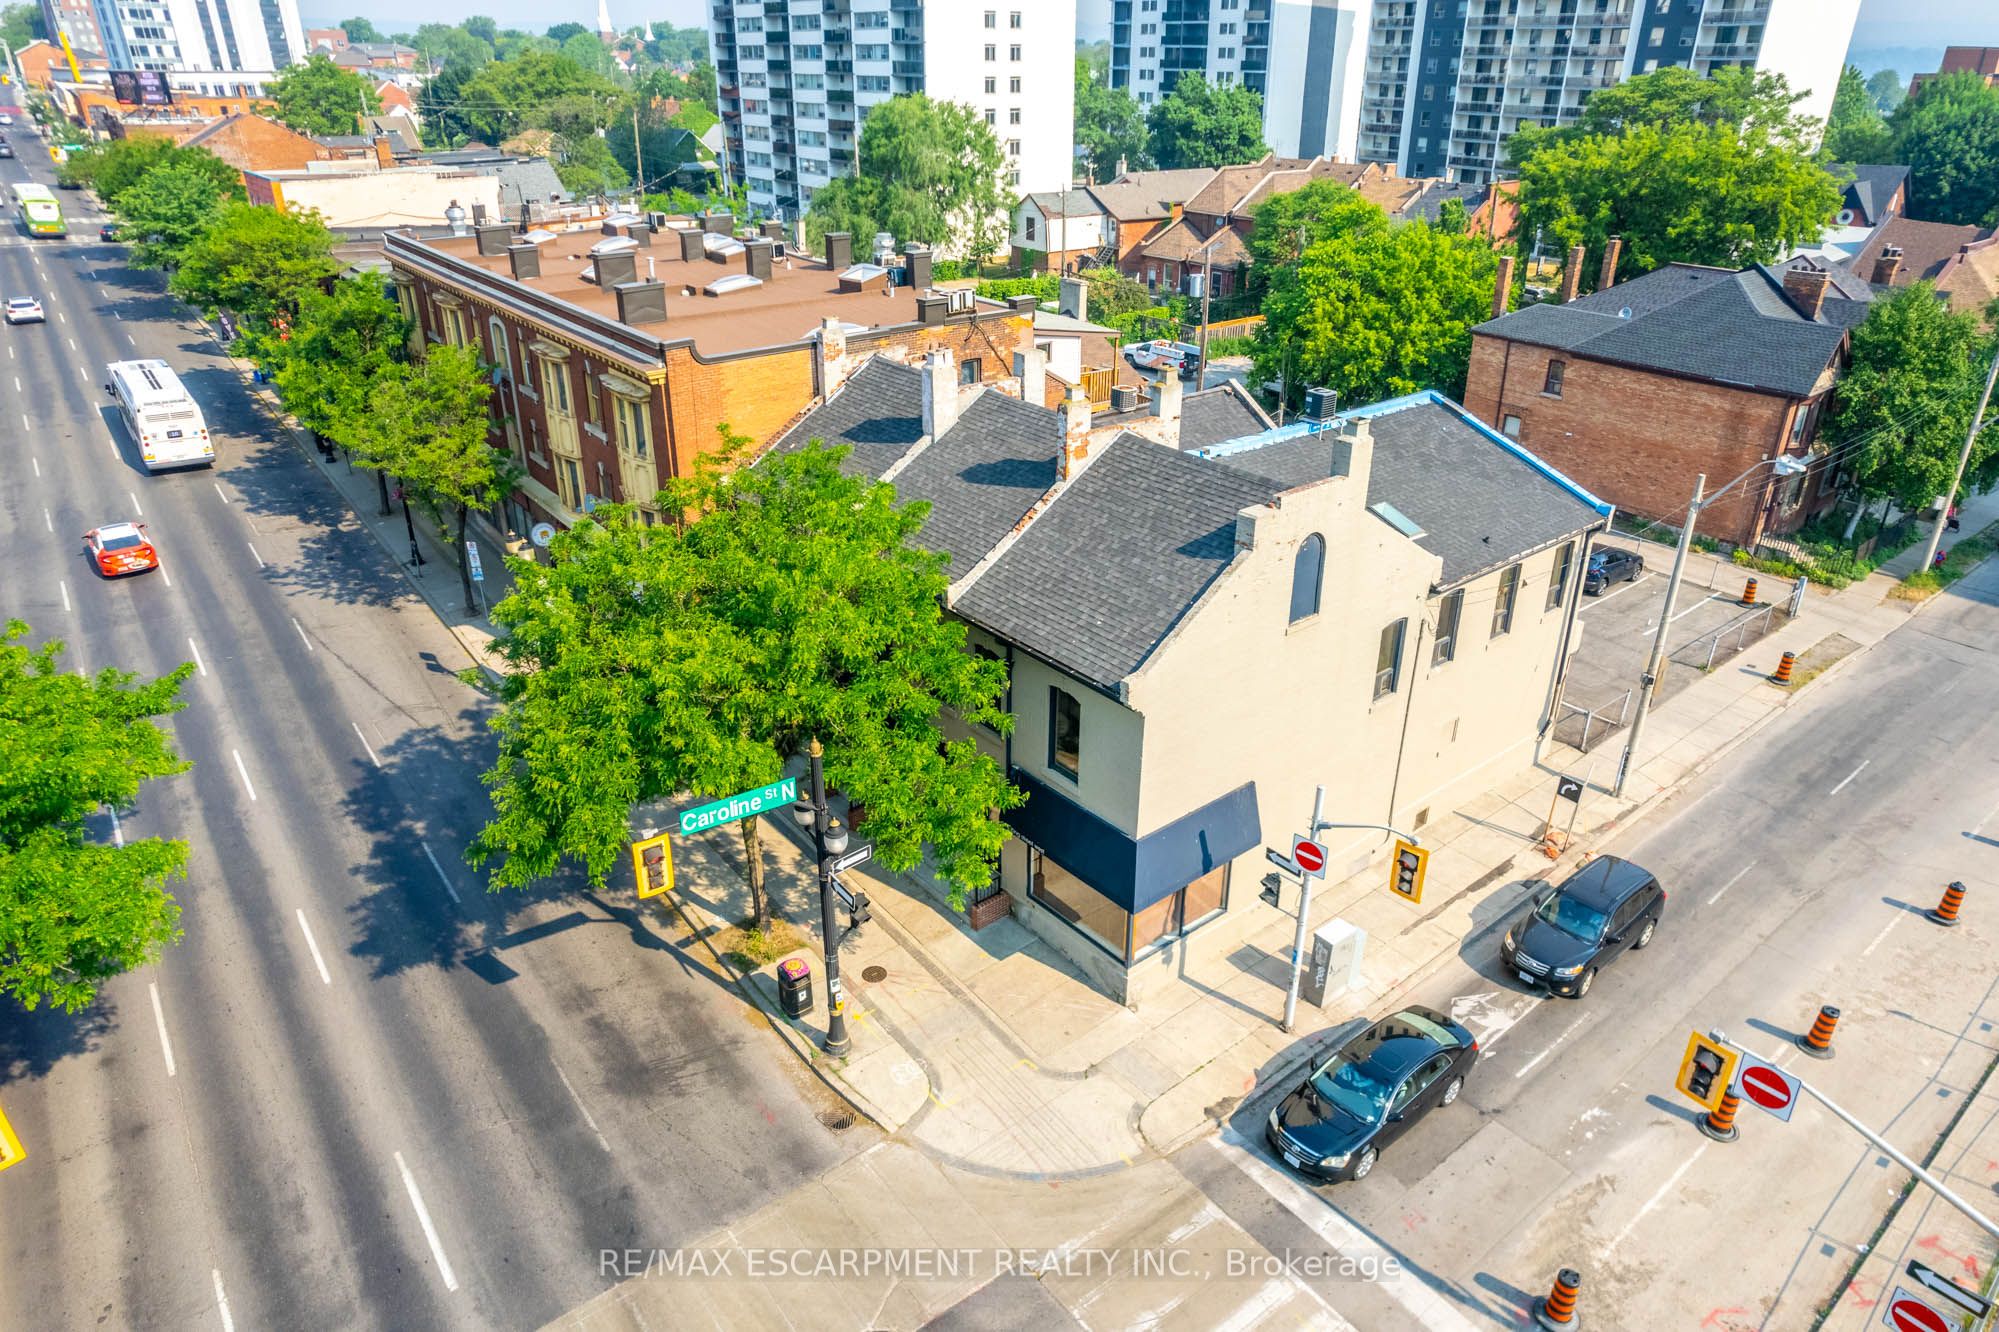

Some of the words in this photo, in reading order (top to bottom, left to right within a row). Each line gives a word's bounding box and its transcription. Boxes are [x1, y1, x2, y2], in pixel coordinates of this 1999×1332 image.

[682, 797, 762, 831] Caroline
[765, 787, 778, 800] St
[781, 782, 795, 801] N
